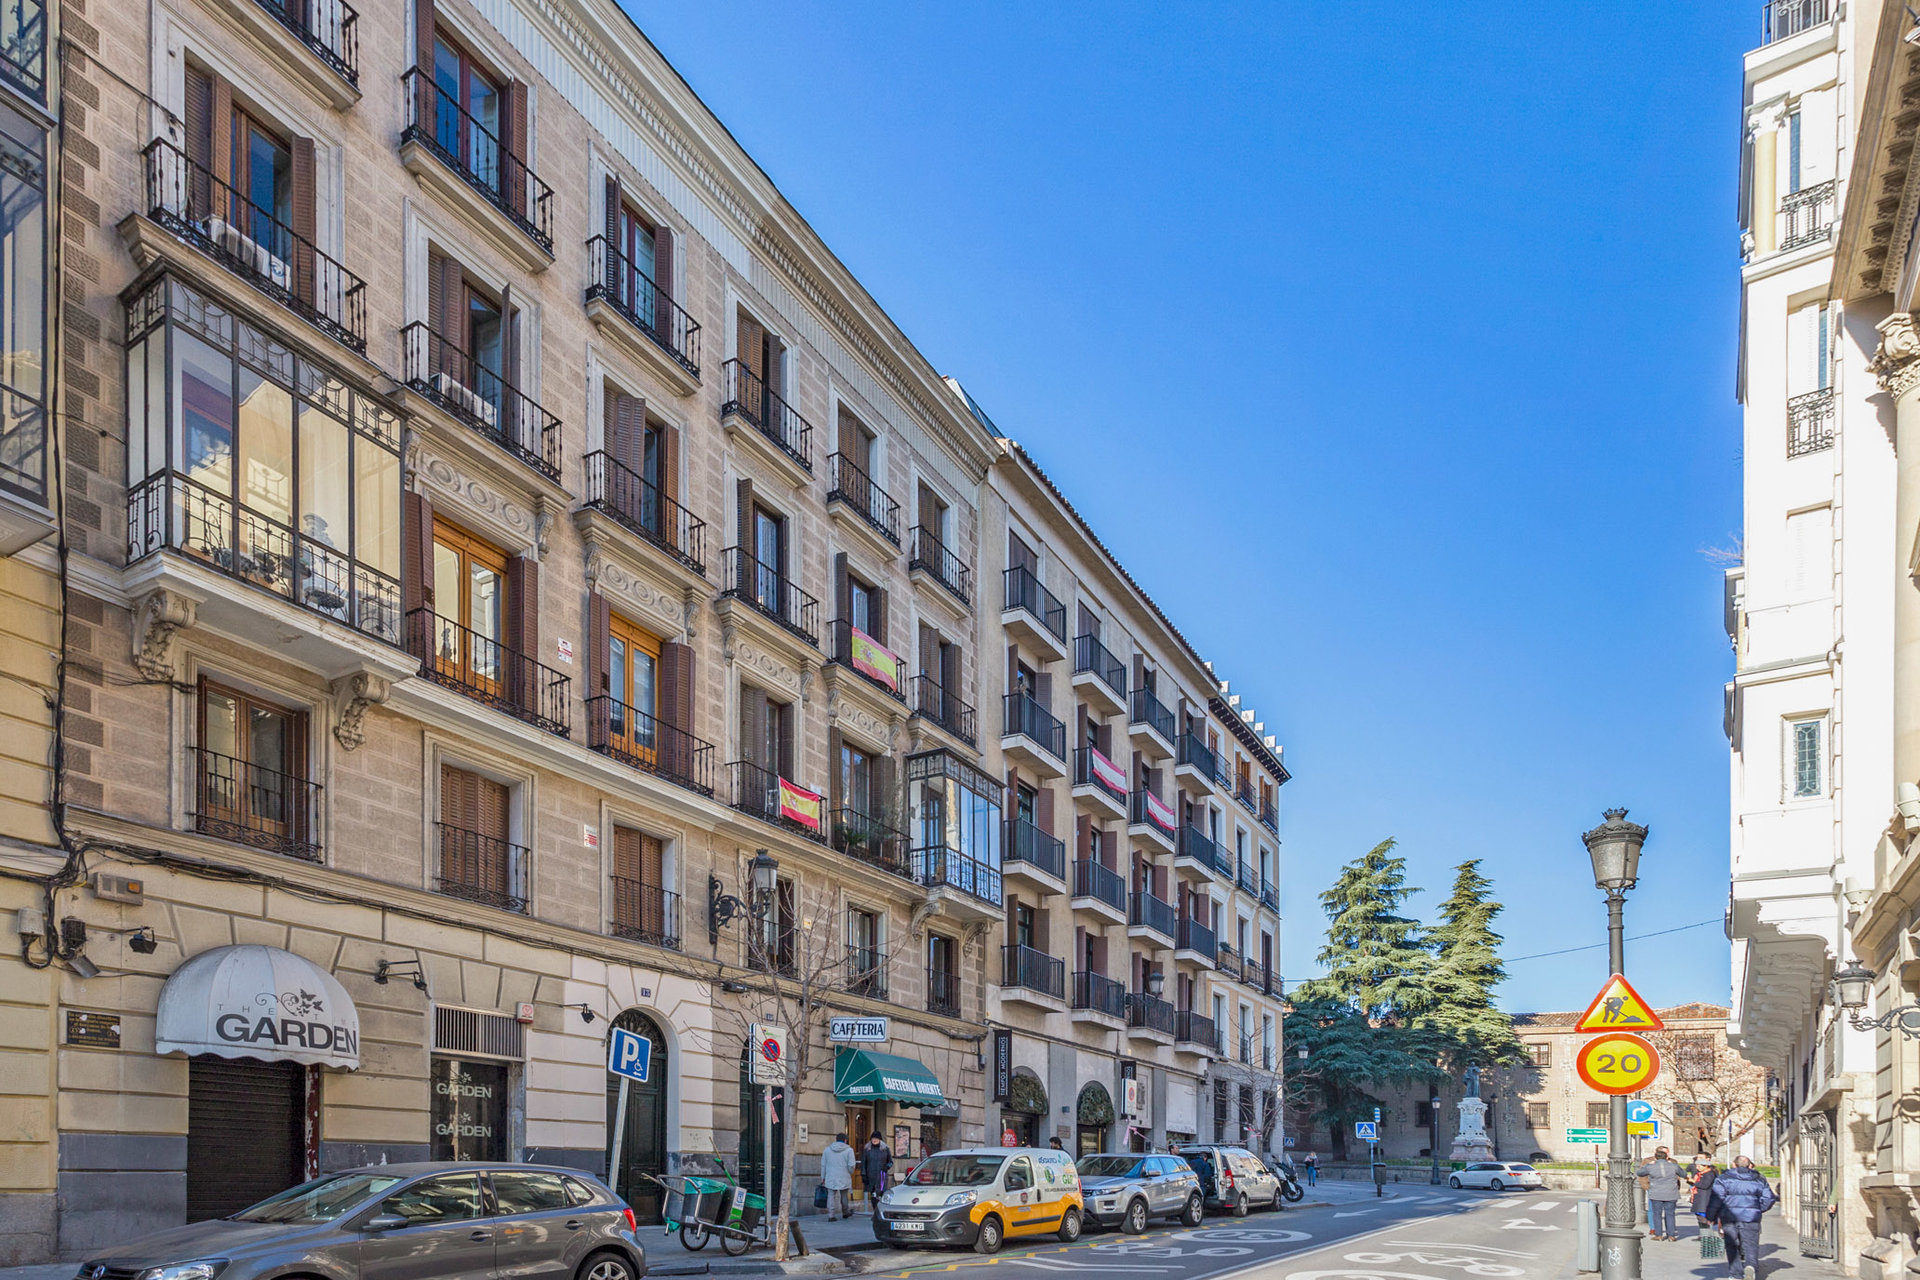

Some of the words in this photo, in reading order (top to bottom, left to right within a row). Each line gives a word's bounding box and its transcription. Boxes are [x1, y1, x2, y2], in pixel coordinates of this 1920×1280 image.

[218, 1003, 275, 1016] THE
[216, 1013, 358, 1055] GARDEN
[832, 1023, 884, 1036] CAFETERIA
[620, 1035, 639, 1070] P
[1597, 1054, 1642, 1073] 20
[436, 1082, 492, 1099] GARDEN
[882, 1077, 917, 1093] CAFETERÍA
[915, 1081, 942, 1096] ORIENTE
[435, 1123, 492, 1138] GARDEN
